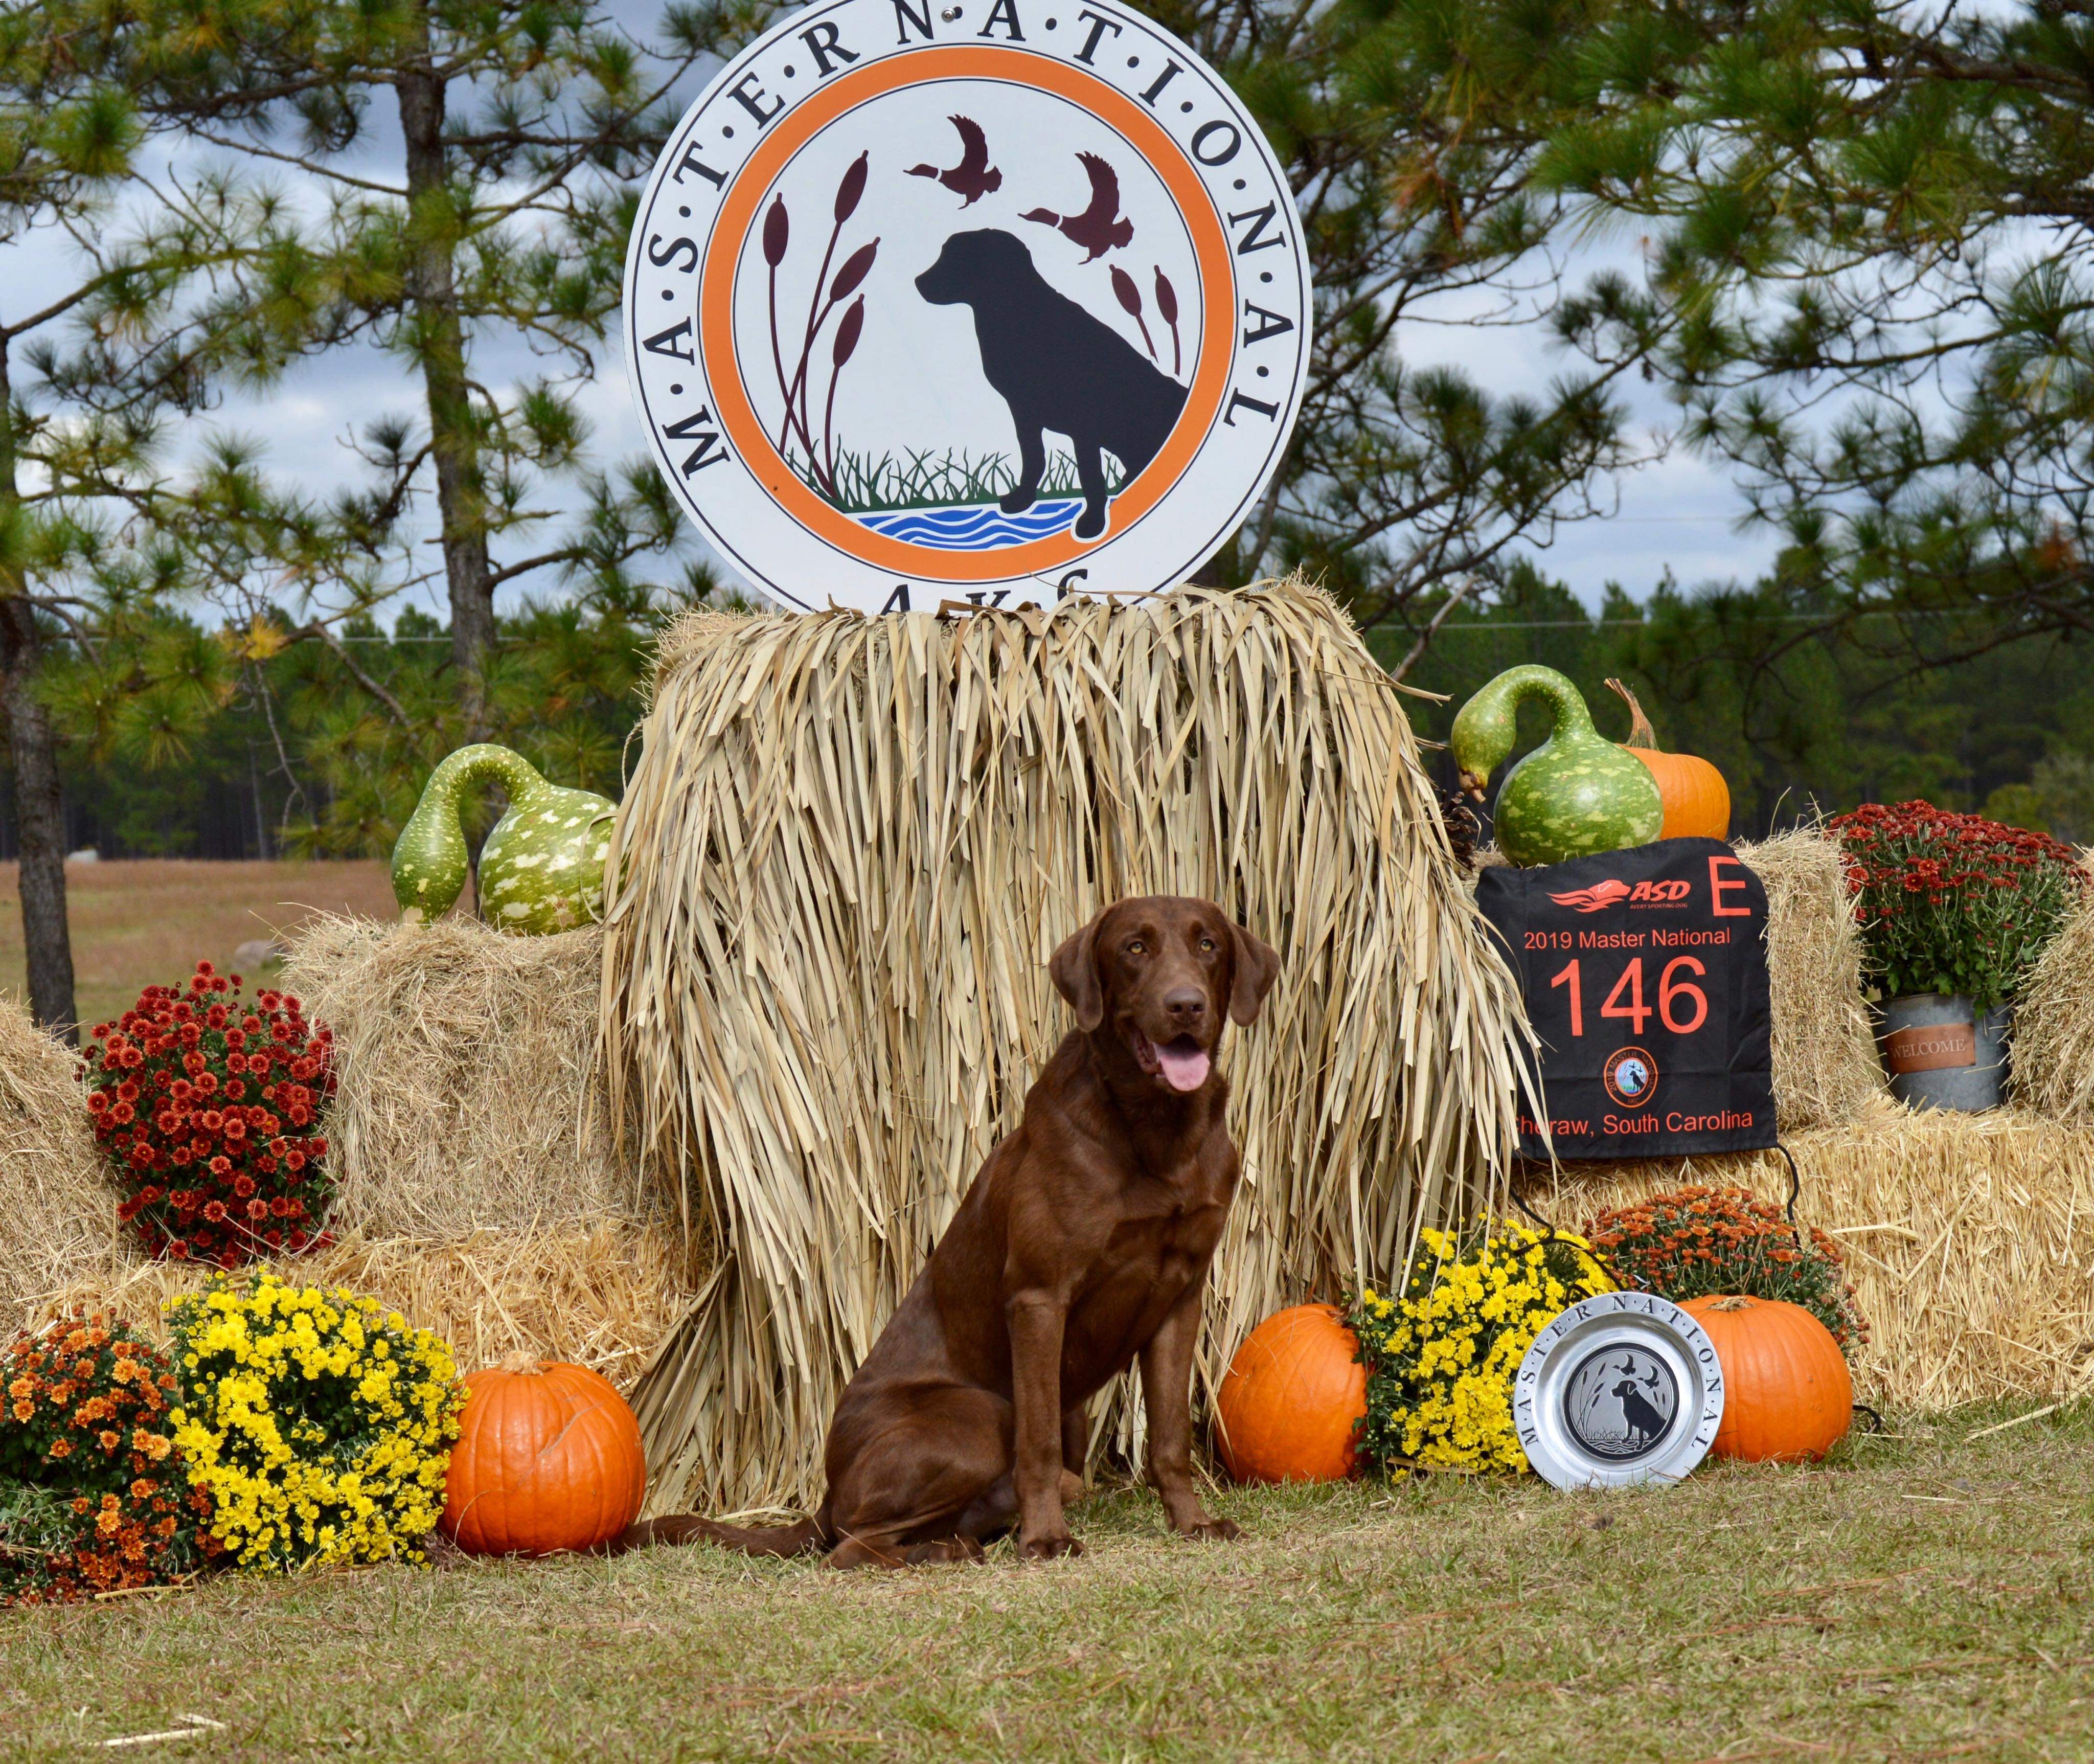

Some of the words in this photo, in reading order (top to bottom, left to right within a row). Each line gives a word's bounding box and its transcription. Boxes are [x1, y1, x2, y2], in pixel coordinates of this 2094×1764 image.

[1629, 880, 1691, 901] ASD
[1708, 856, 1751, 917] E
[1524, 932, 1572, 949] 2019
[1579, 931, 1646, 948] Master
[1652, 927, 1730, 946] National
[1551, 956, 1709, 1036] 146
[1892, 1038, 1966, 1059] WELCOME
[1609, 1051, 1637, 1069] MASTER
[1607, 1071, 1617, 1093] 2019
[1641, 1054, 1655, 1089] NATIONAL
[1603, 1113, 1658, 1135] South
[1666, 1110, 1752, 1133] Carolina
